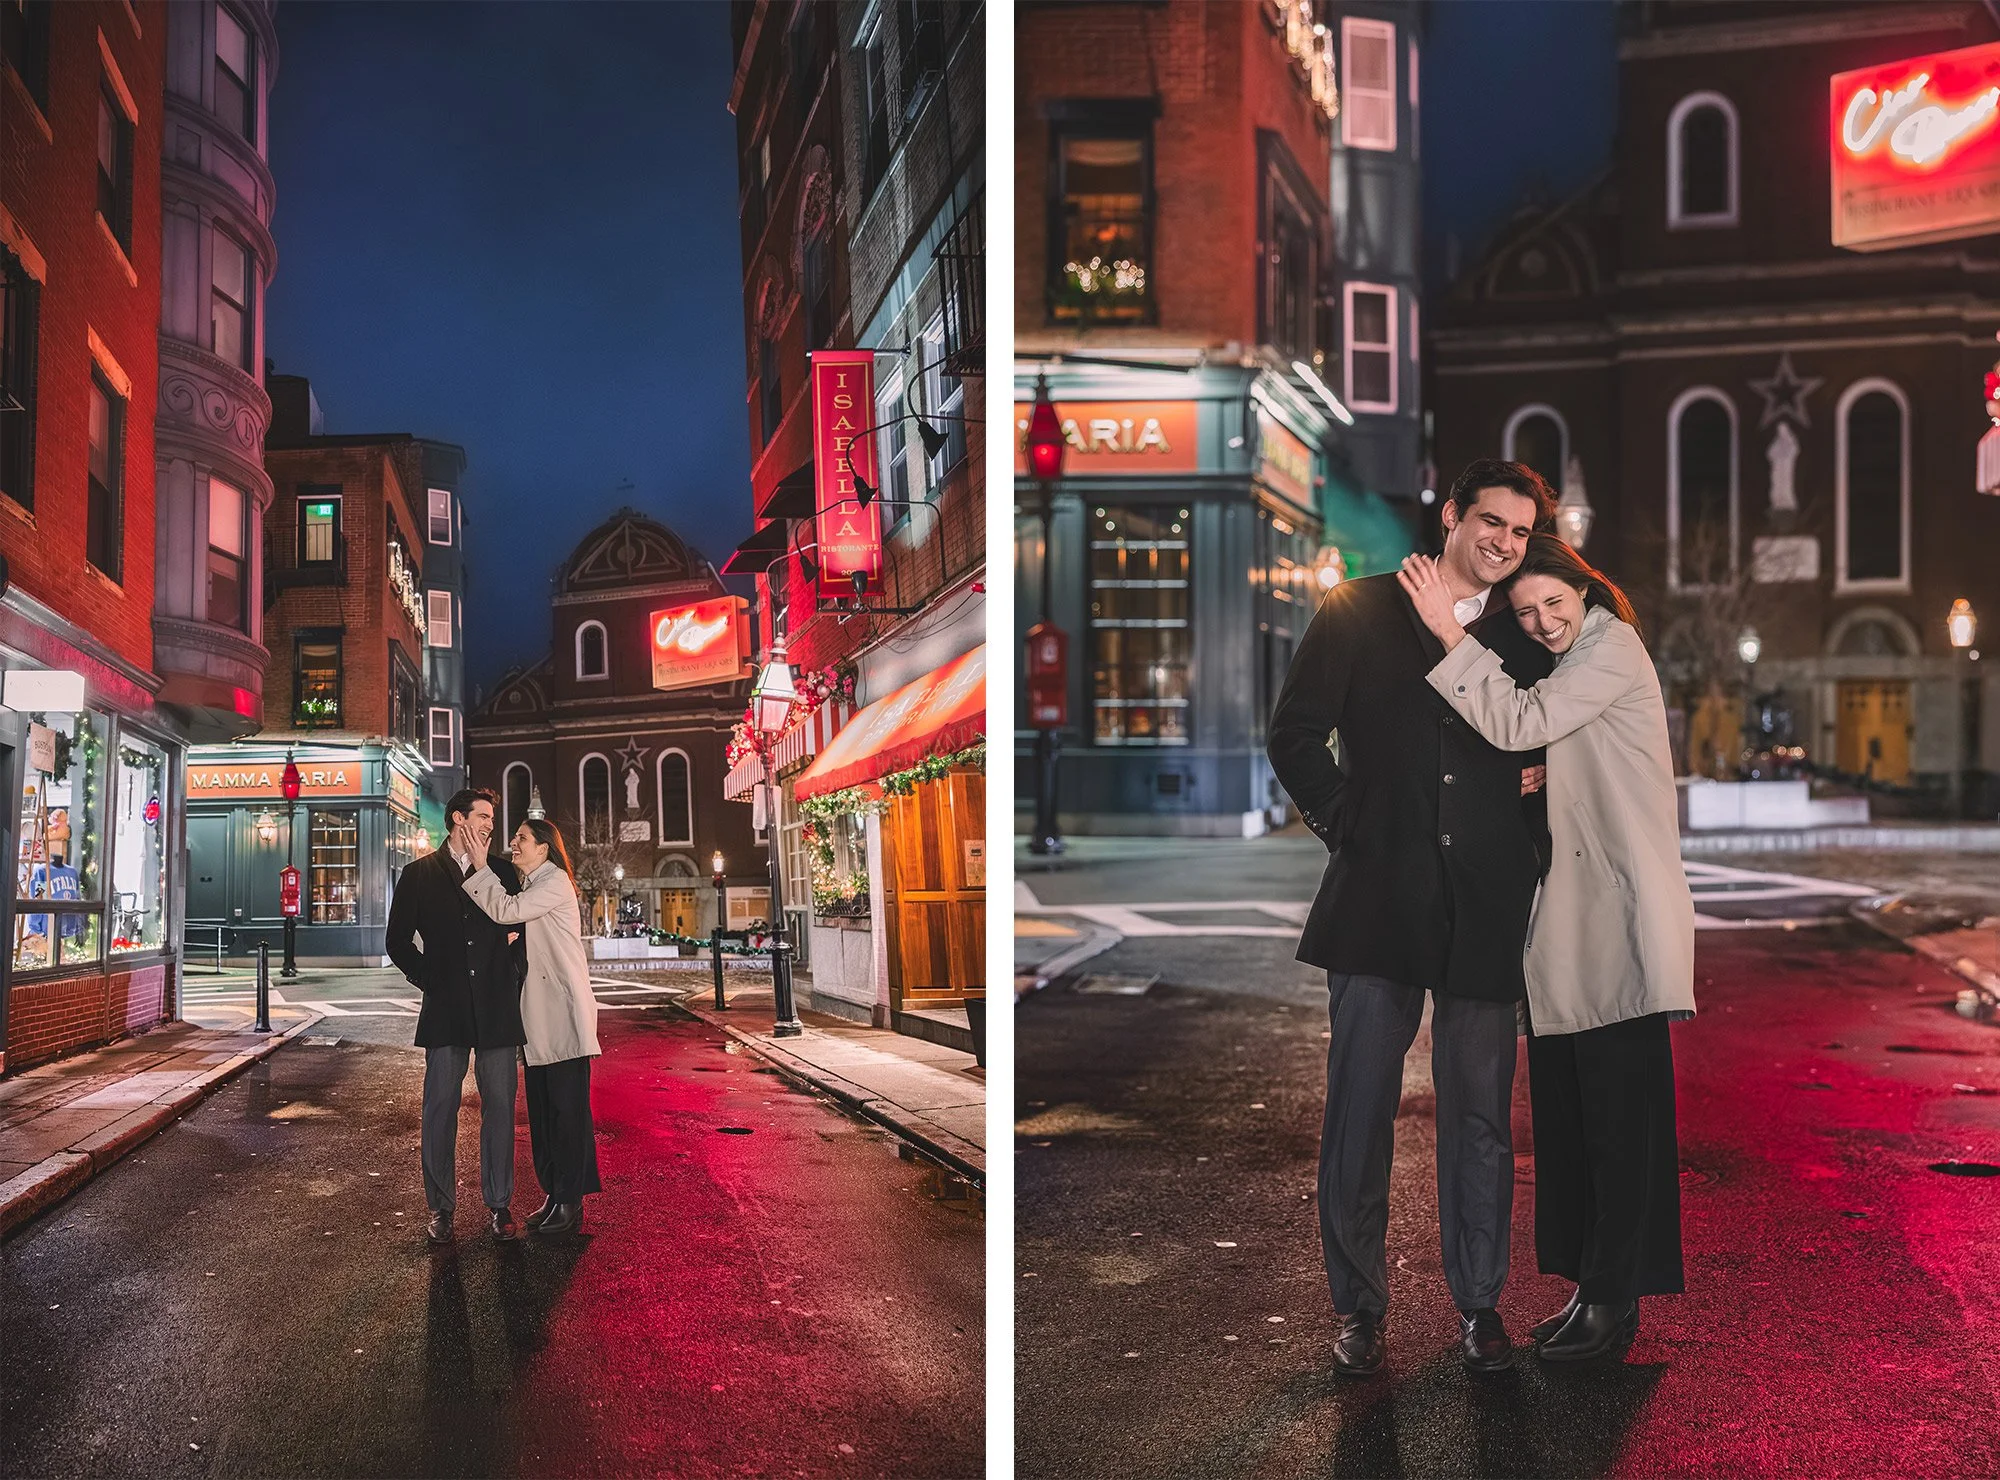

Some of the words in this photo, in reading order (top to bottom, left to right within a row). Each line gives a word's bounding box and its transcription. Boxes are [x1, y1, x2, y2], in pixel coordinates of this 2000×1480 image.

[832, 373, 861, 537] ISABELLA
[1017, 418, 1172, 455] ARIA
[821, 544, 880, 553] RISTORANTE
[868, 661, 986, 729] ISABELL
[191, 771, 272, 789] MAMMA
[278, 770, 349, 787] ARIA
